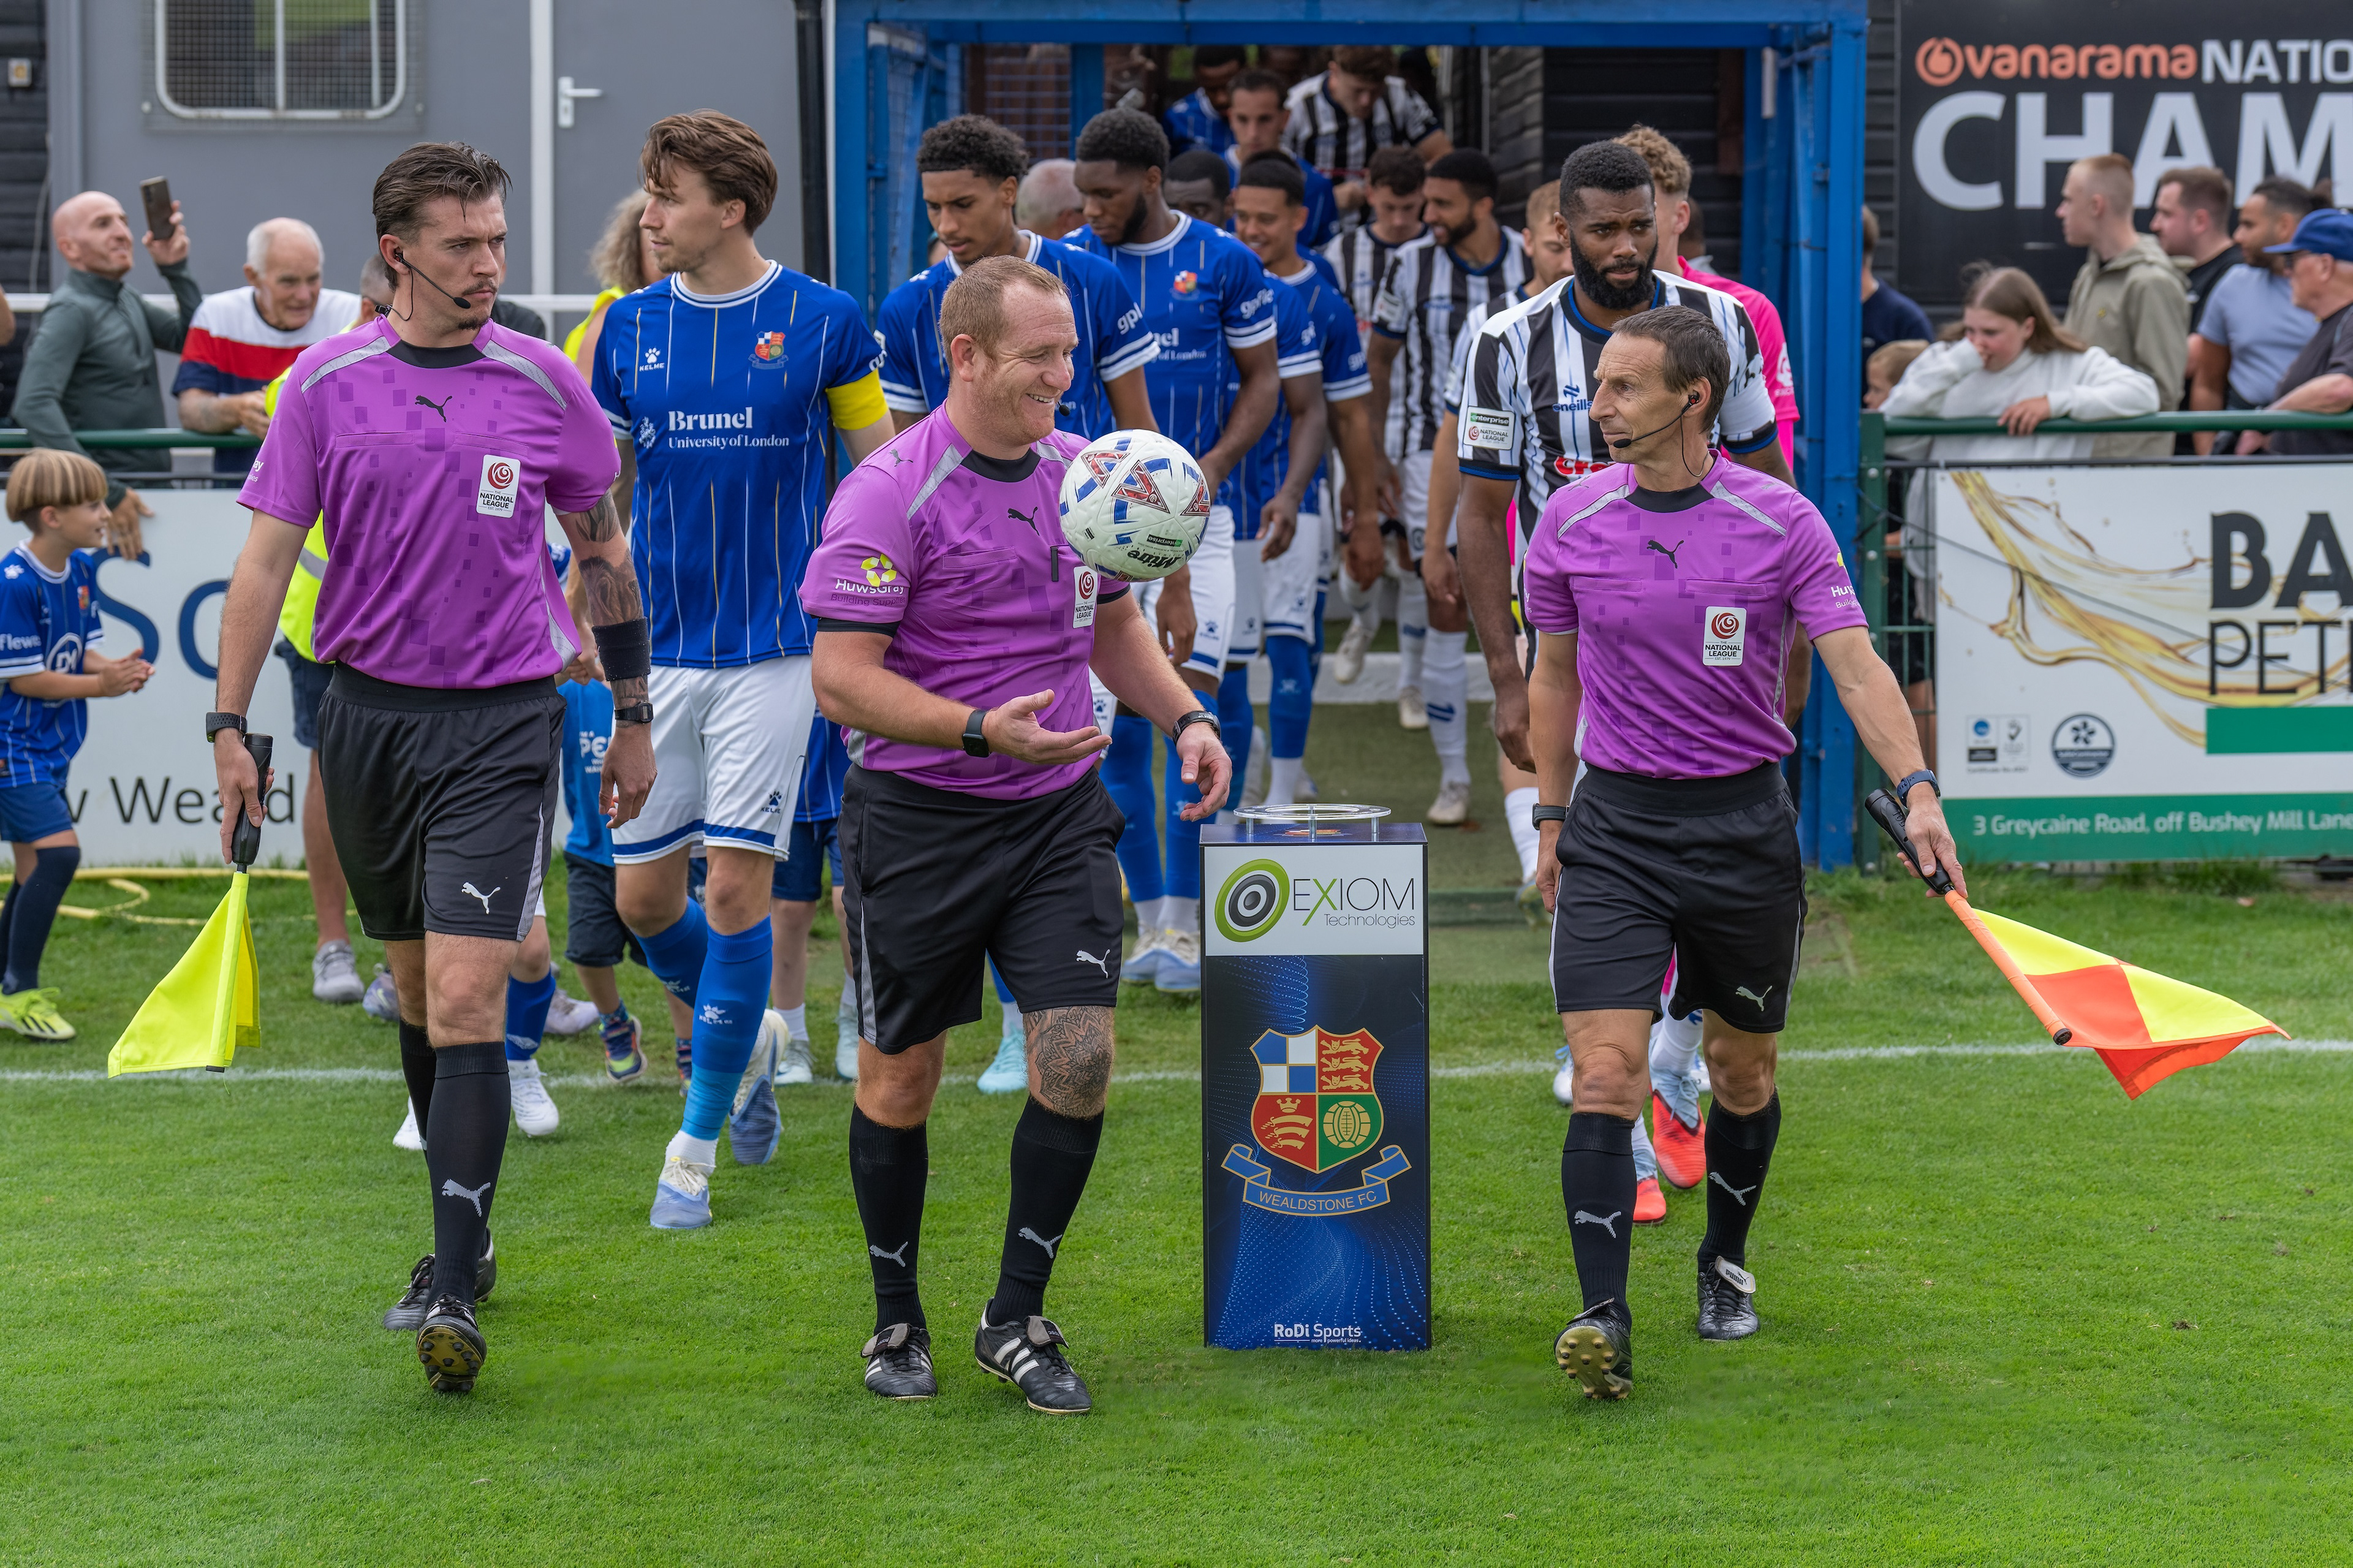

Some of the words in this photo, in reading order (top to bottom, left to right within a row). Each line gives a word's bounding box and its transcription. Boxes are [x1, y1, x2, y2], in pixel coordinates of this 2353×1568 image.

[1965, 44, 2197, 80] vanarama
[639, 363, 665, 372] KELME
[668, 406, 752, 431] Brunel
[1471, 412, 1509, 425] enterprise
[1480, 429, 1509, 437] NATIONAL
[669, 435, 728, 450] University
[729, 434, 744, 447] of
[744, 434, 789, 447] London
[480, 493, 513, 502] NATIONAL
[483, 499, 509, 509] LEAGUE
[1127, 550, 1181, 569] Mitre
[2210, 511, 2353, 608] BA
[831, 593, 870, 606] Building
[873, 597, 906, 606] Supplies
[1075, 604, 1094, 613] NATIONAL
[2208, 619, 2353, 697] PET
[1972, 814, 1987, 836] 3
[1991, 814, 2091, 839] Greycaine
[2153, 811, 2184, 833] off
[2188, 811, 2263, 836] Bushey
[2268, 809, 2304, 831] Mill
[1294, 878, 1414, 926] EXIOM
[1324, 913, 1415, 928] Technologies
[1259, 1191, 1354, 1211] WEALDSTONE
[1358, 1191, 1377, 1206] FC
[1274, 1324, 1310, 1338] RoDi
[1313, 1323, 1362, 1343] Sports
